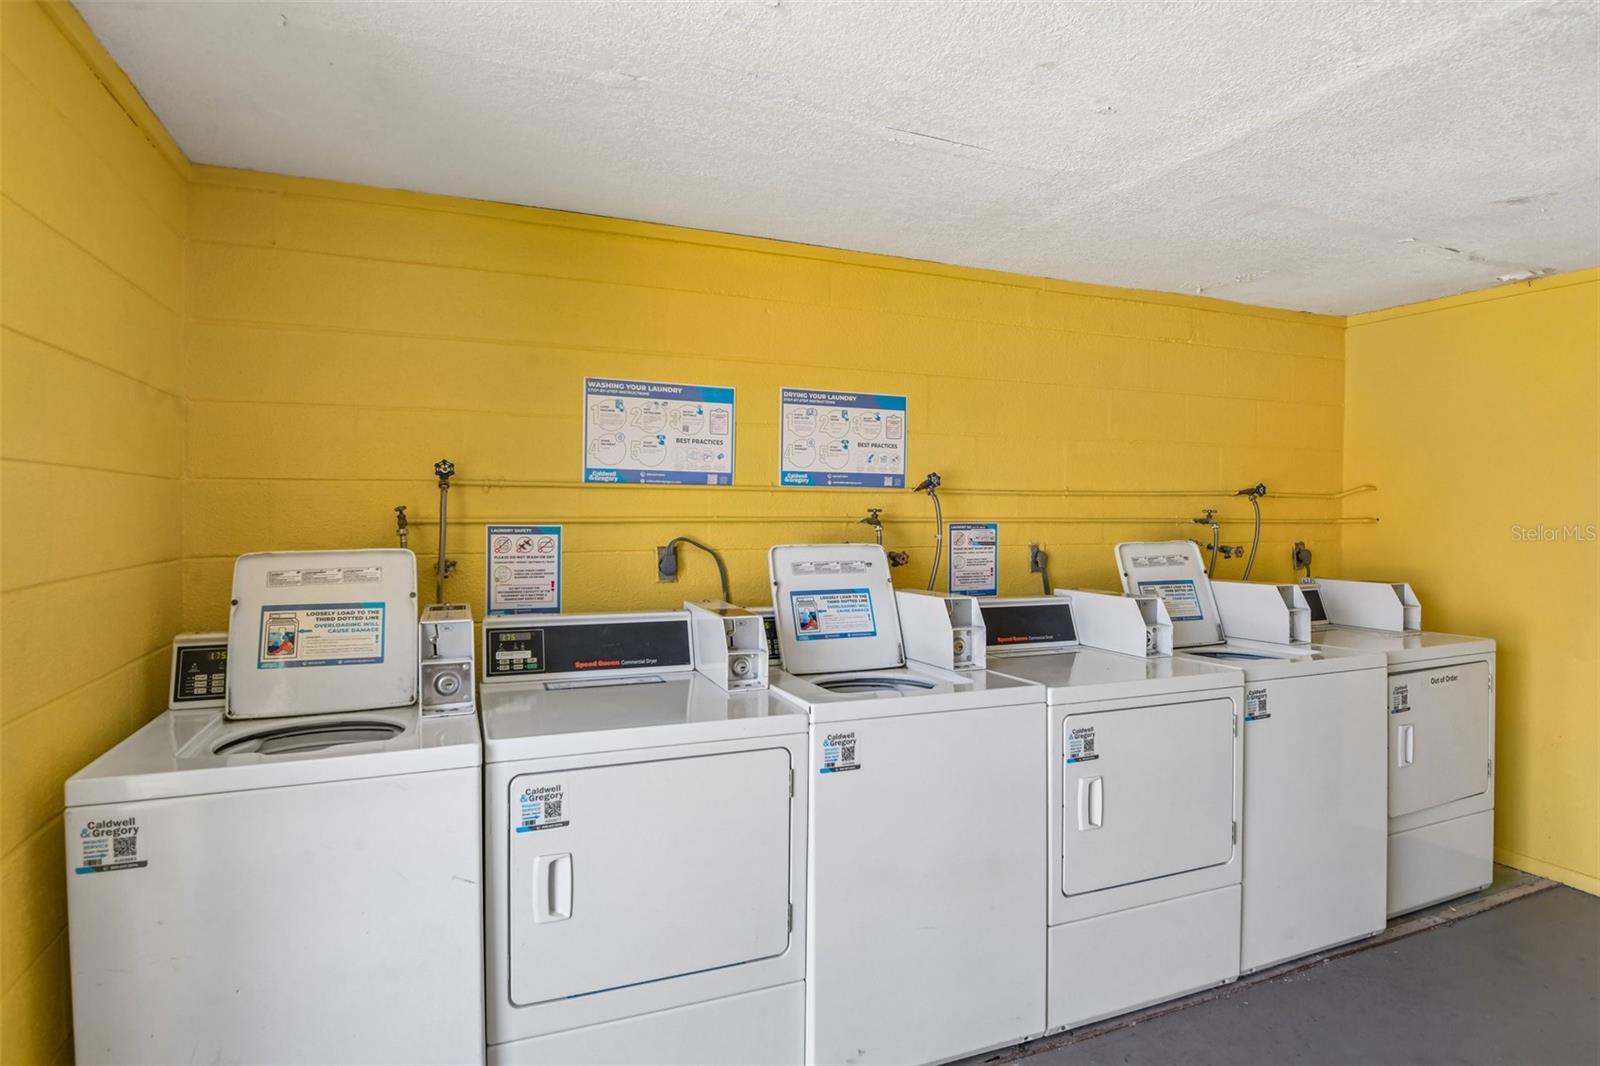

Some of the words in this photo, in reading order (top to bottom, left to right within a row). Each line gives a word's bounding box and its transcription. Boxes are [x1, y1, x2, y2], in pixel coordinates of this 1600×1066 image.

[587, 381, 625, 390] WASHING
[625, 383, 647, 391] YOUR
[648, 385, 683, 394] LAUNDRY
[783, 391, 808, 399] DRYING
[692, 438, 724, 446] PRACTICES
[1440, 675, 1446, 683] of
[827, 731, 855, 741] Caldwell
[830, 739, 857, 747] Gregory
[525, 784, 561, 796] Caldwell
[529, 792, 564, 802] Gregory
[87, 816, 136, 830] Caldwell
[80, 828, 91, 838] &
[92, 826, 140, 838] Gregory
